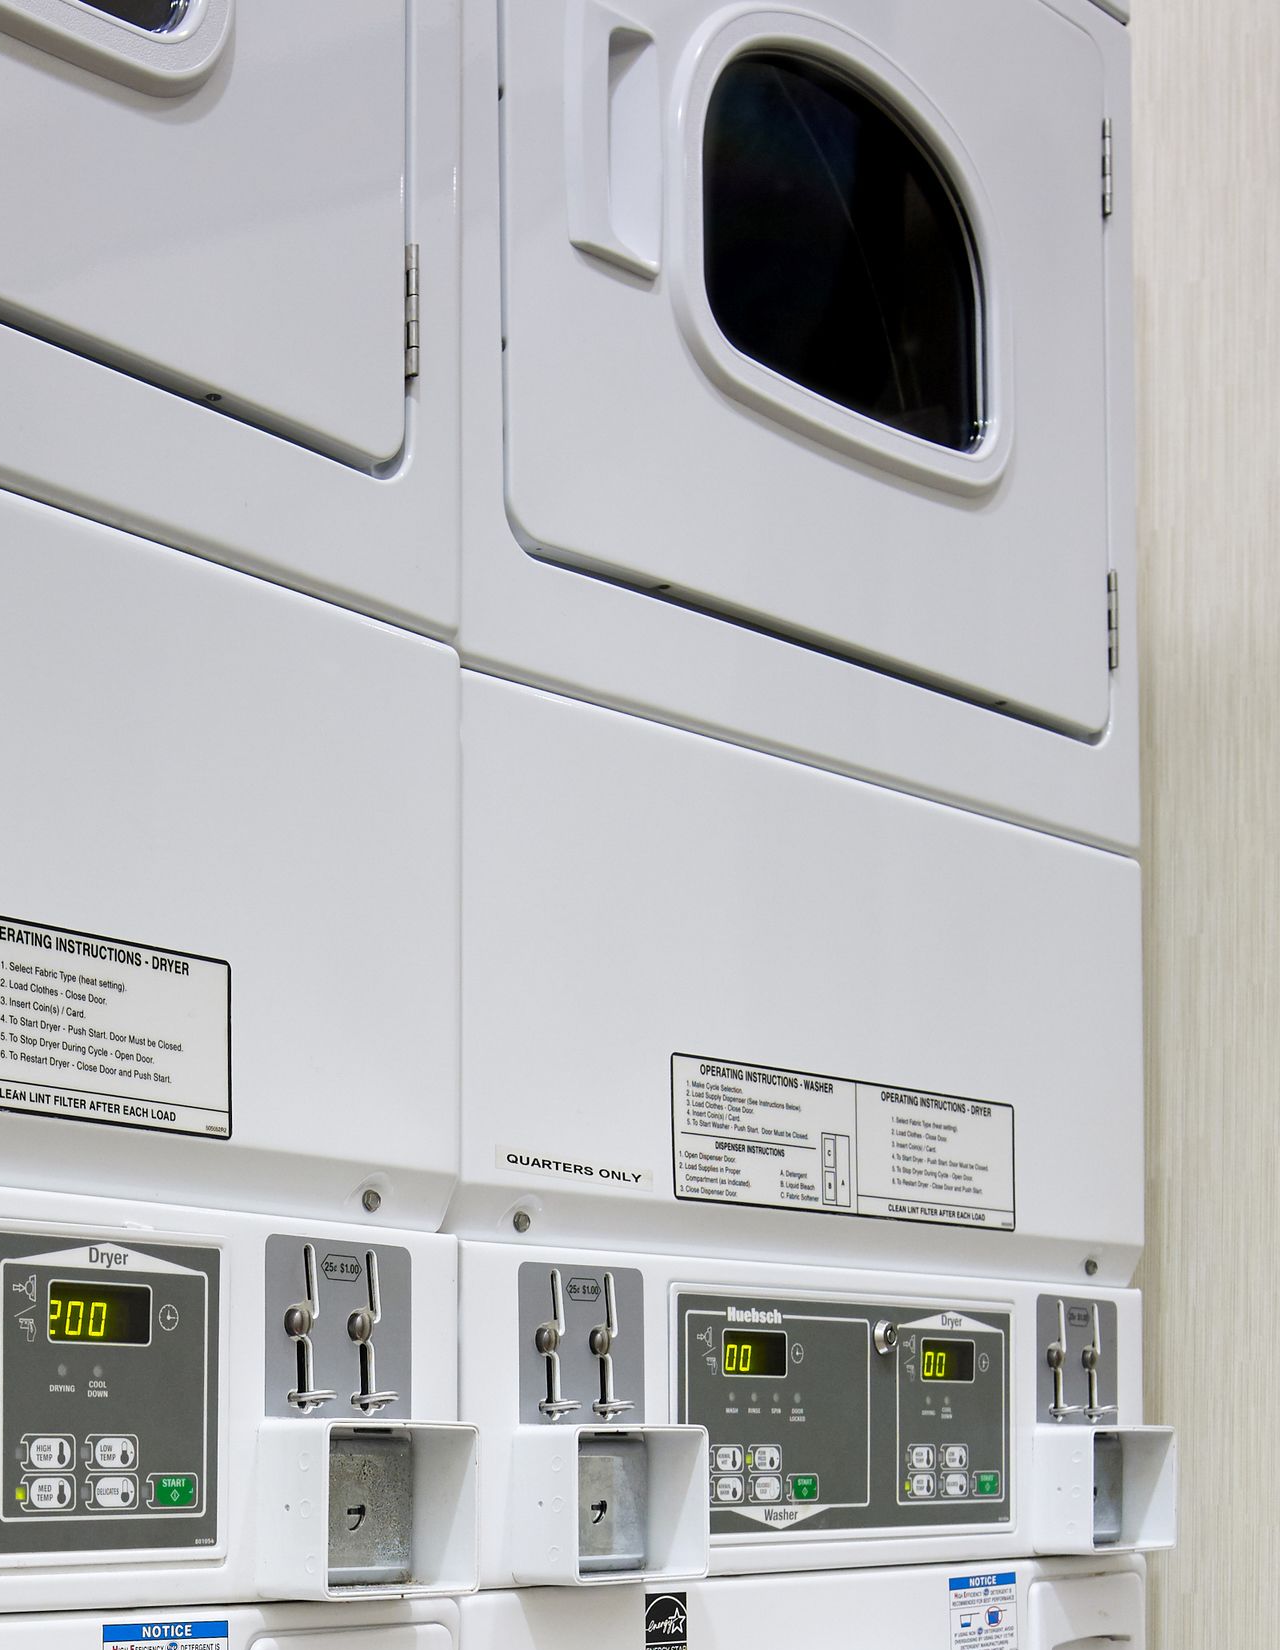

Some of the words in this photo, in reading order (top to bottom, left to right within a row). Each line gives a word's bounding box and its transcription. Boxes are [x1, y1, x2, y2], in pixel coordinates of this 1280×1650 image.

[55, 936, 142, 967] INSTRUCTIONS
[151, 955, 190, 976] DRYER
[699, 1063, 744, 1081] OPERATING
[745, 1070, 799, 1089] INSTRUCTIONS
[803, 1079, 834, 1094] WASHER
[29, 1091, 52, 1105] LINT
[53, 1095, 87, 1110] FILTER
[89, 1100, 121, 1115] AFTER
[122, 1104, 149, 1119] EACH
[151, 1108, 176, 1122] LOAD
[880, 1090, 919, 1107] OPERATING
[919, 1097, 966, 1114] INSTRUCTIONS
[970, 1104, 992, 1117] DRYER
[714, 1140, 746, 1153] DISPENSER
[746, 1144, 785, 1158] INSTRUCTIONS
[506, 1153, 594, 1176] QUARTERS
[598, 1168, 642, 1183] ONLY
[887, 1203, 907, 1213] CLEAN
[907, 1206, 920, 1214] LINT
[920, 1207, 938, 1217] FILTER
[938, 1209, 956, 1218] AFTER
[956, 1210, 971, 1220] EACH
[971, 1212, 986, 1222] LOAD
[88, 1246, 129, 1267] Dryer
[339, 1263, 360, 1275] $1.00
[582, 1286, 599, 1295] $1.00
[727, 1306, 782, 1324] Huebsch
[940, 1314, 963, 1330] Dryer
[49, 1384, 76, 1393] DRYING
[88, 1380, 107, 1389] COOL
[87, 1389, 109, 1398] DOWN
[36, 1444, 52, 1453] HIGH
[99, 1444, 113, 1453] LOW
[36, 1453, 53, 1462] TEMP
[100, 1453, 116, 1461] TEMP
[162, 1478, 186, 1488] START
[797, 1478, 813, 1486] START
[37, 1484, 52, 1493] MED
[36, 1493, 54, 1502] TEMP
[764, 1508, 799, 1523] Washer
[969, 1575, 997, 1587] NOTICE
[142, 1624, 193, 1638] NOTICE
